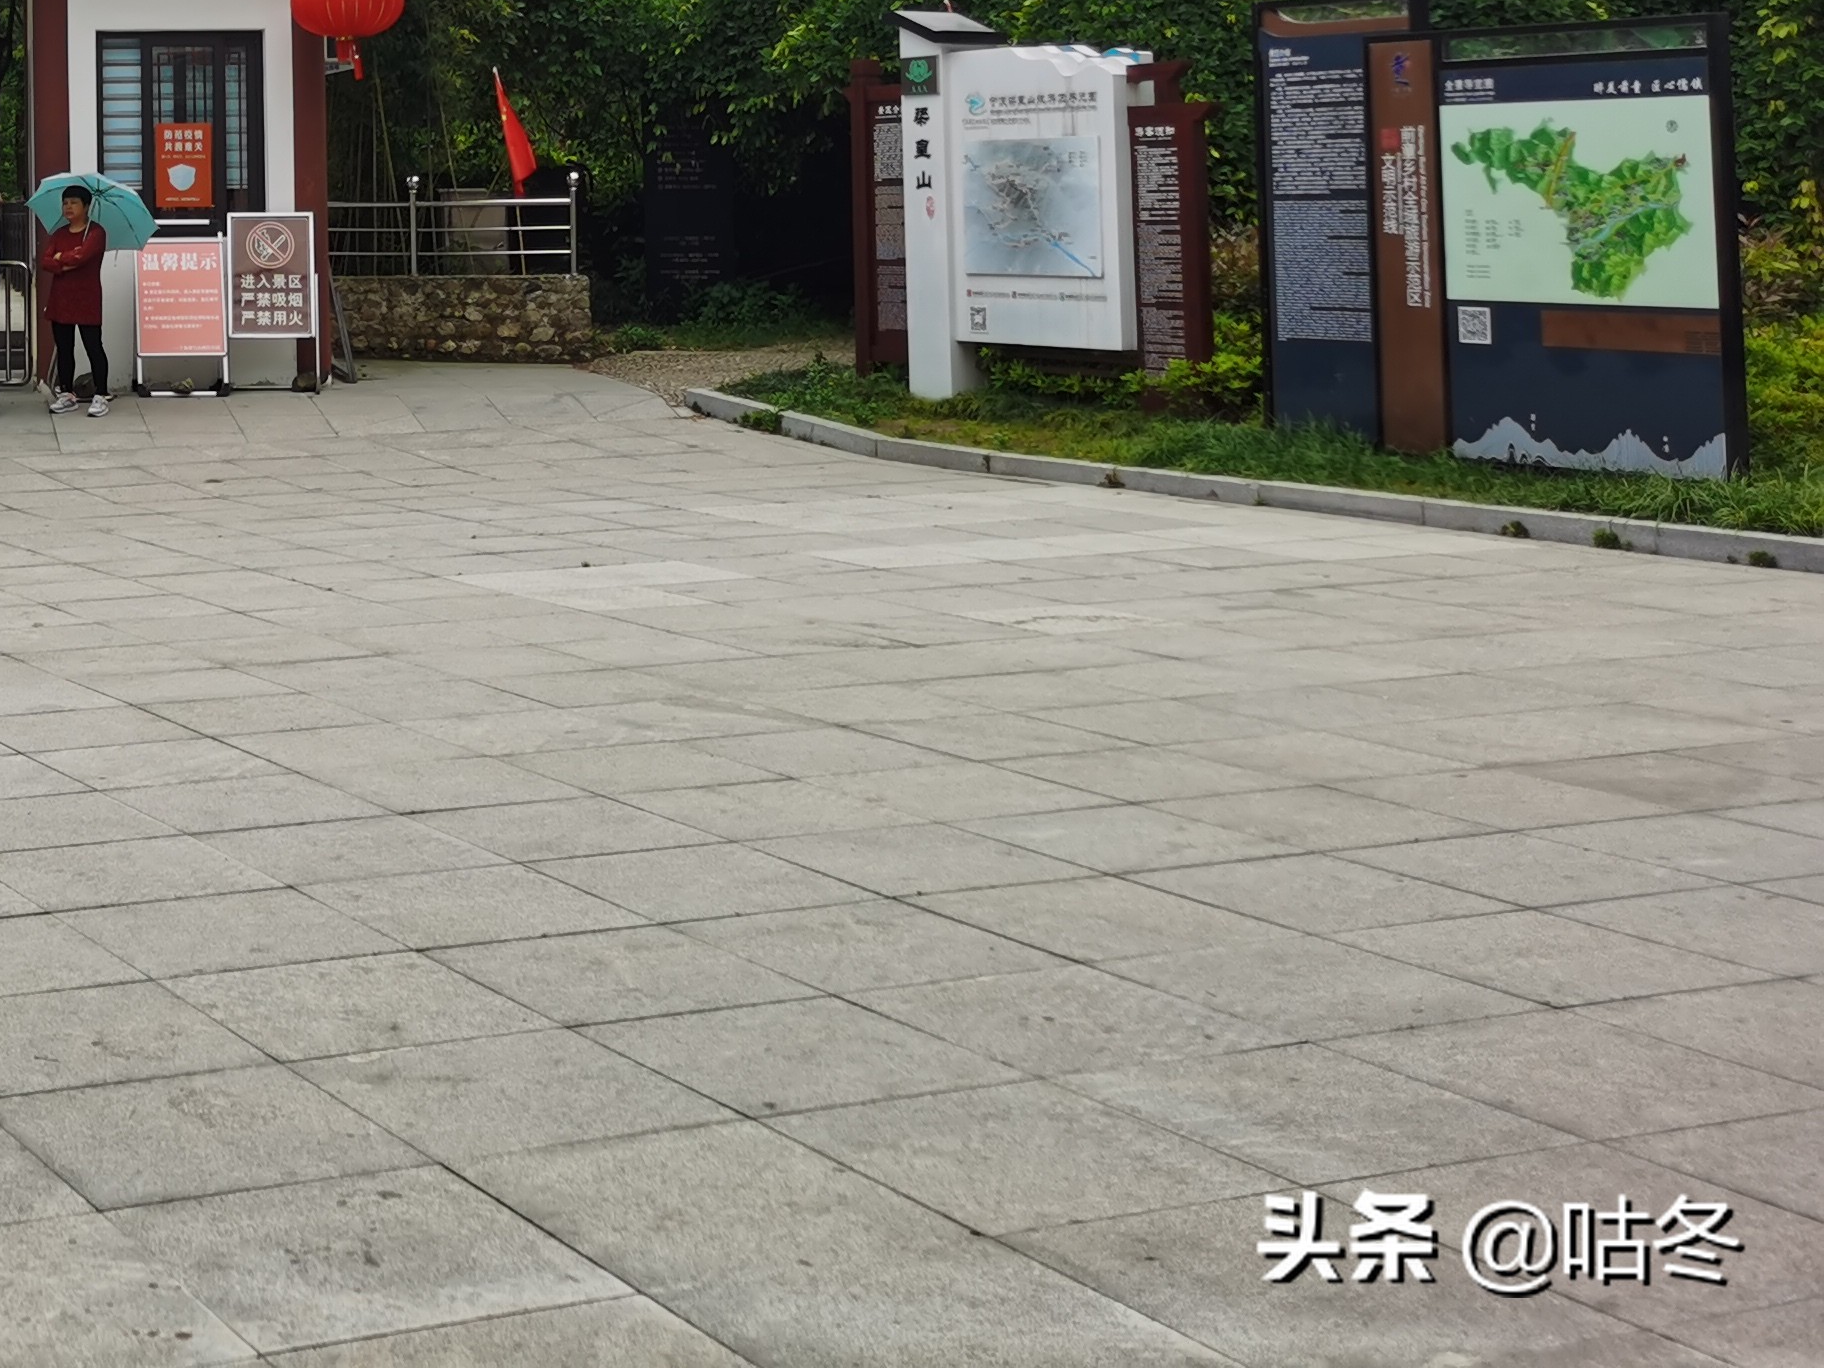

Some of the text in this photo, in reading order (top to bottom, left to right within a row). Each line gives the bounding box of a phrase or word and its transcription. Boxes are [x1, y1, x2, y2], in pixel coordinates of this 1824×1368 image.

[913, 107, 932, 190] 梁皇山
[142, 252, 217, 271] 温馨提示
[240, 274, 302, 289] 进入景区
[241, 292, 303, 307] 严禁吸烟
[241, 310, 303, 326] 严禁用火
